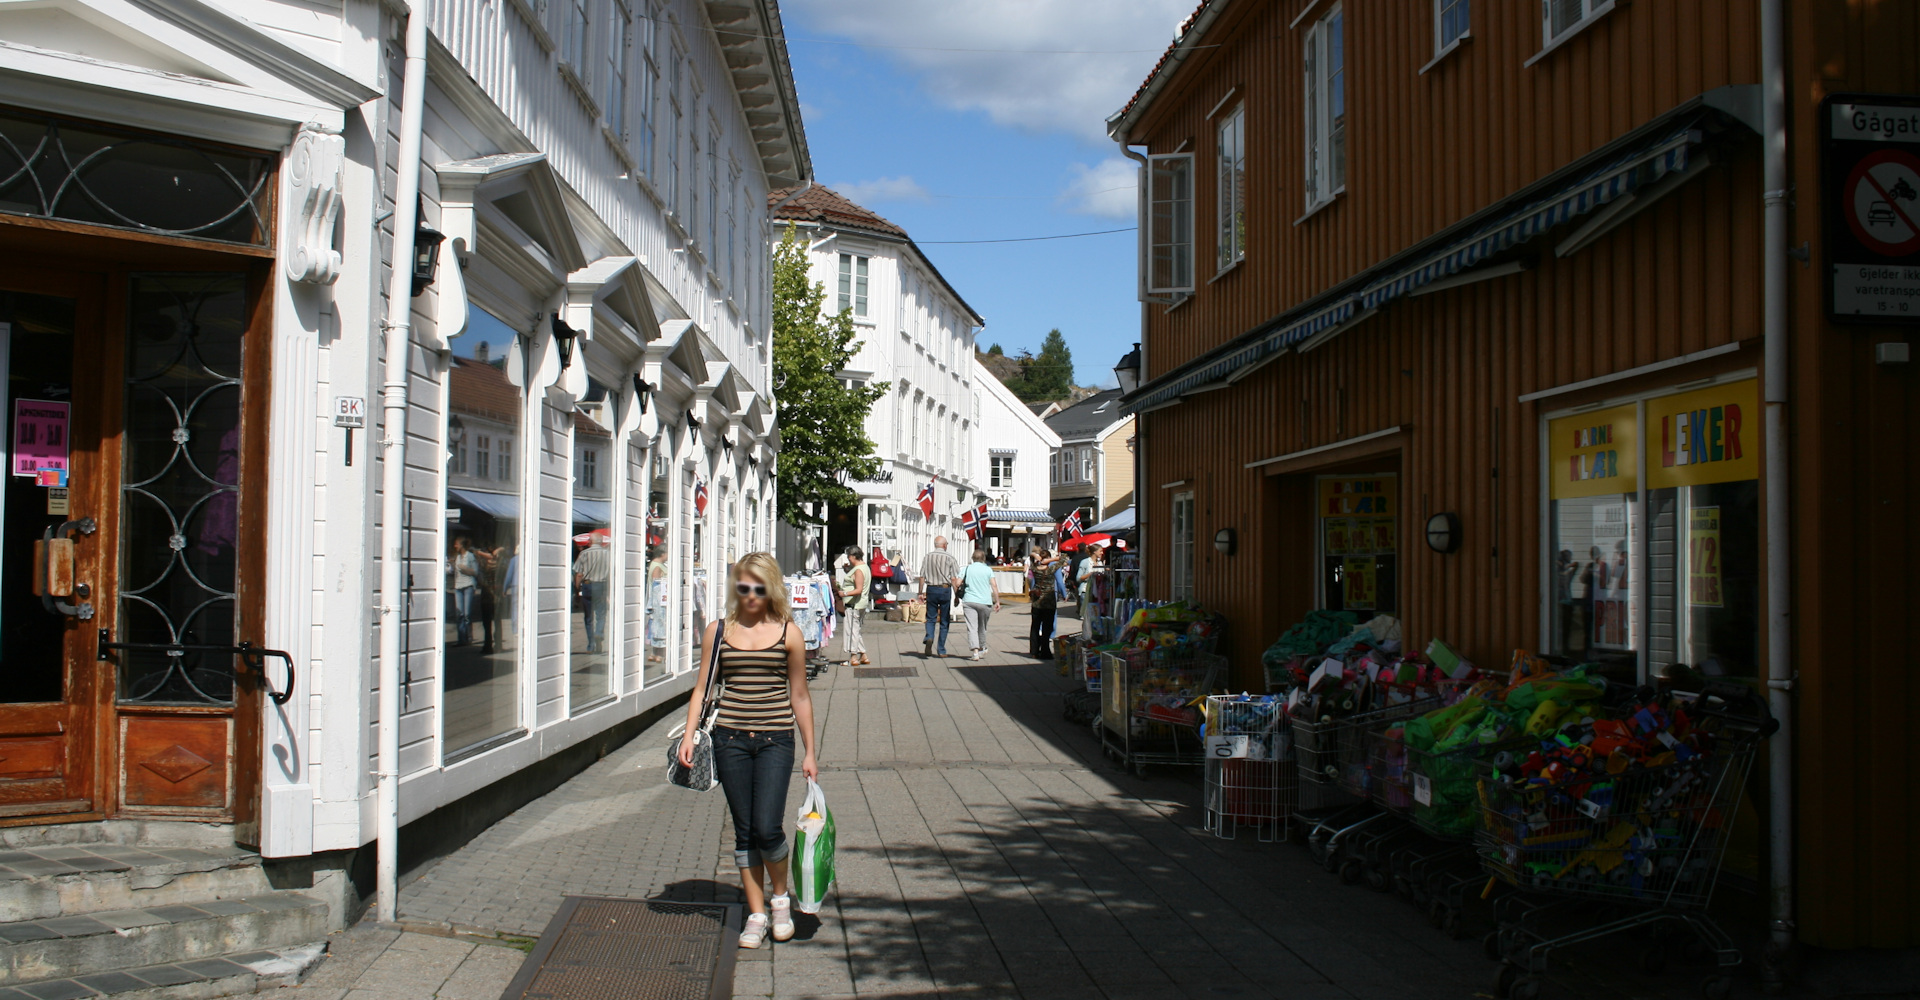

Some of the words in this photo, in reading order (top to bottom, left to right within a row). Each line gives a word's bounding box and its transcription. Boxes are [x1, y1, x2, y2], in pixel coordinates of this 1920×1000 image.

[1859, 267, 1900, 281] Gjelder
[1877, 302, 1887, 311] 15
[1899, 302, 1909, 312] 10
[341, 399, 359, 414] BK
[1574, 424, 1613, 449] BARNE
[1661, 403, 1743, 468] LEKER
[1570, 450, 1618, 482] KLÆR
[1334, 481, 1382, 494] BARNE
[1329, 496, 1387, 514] KLÆR
[795, 585, 805, 595] 1/2
[1594, 600, 1627, 644] PRI
[1215, 739, 1233, 757] 10
